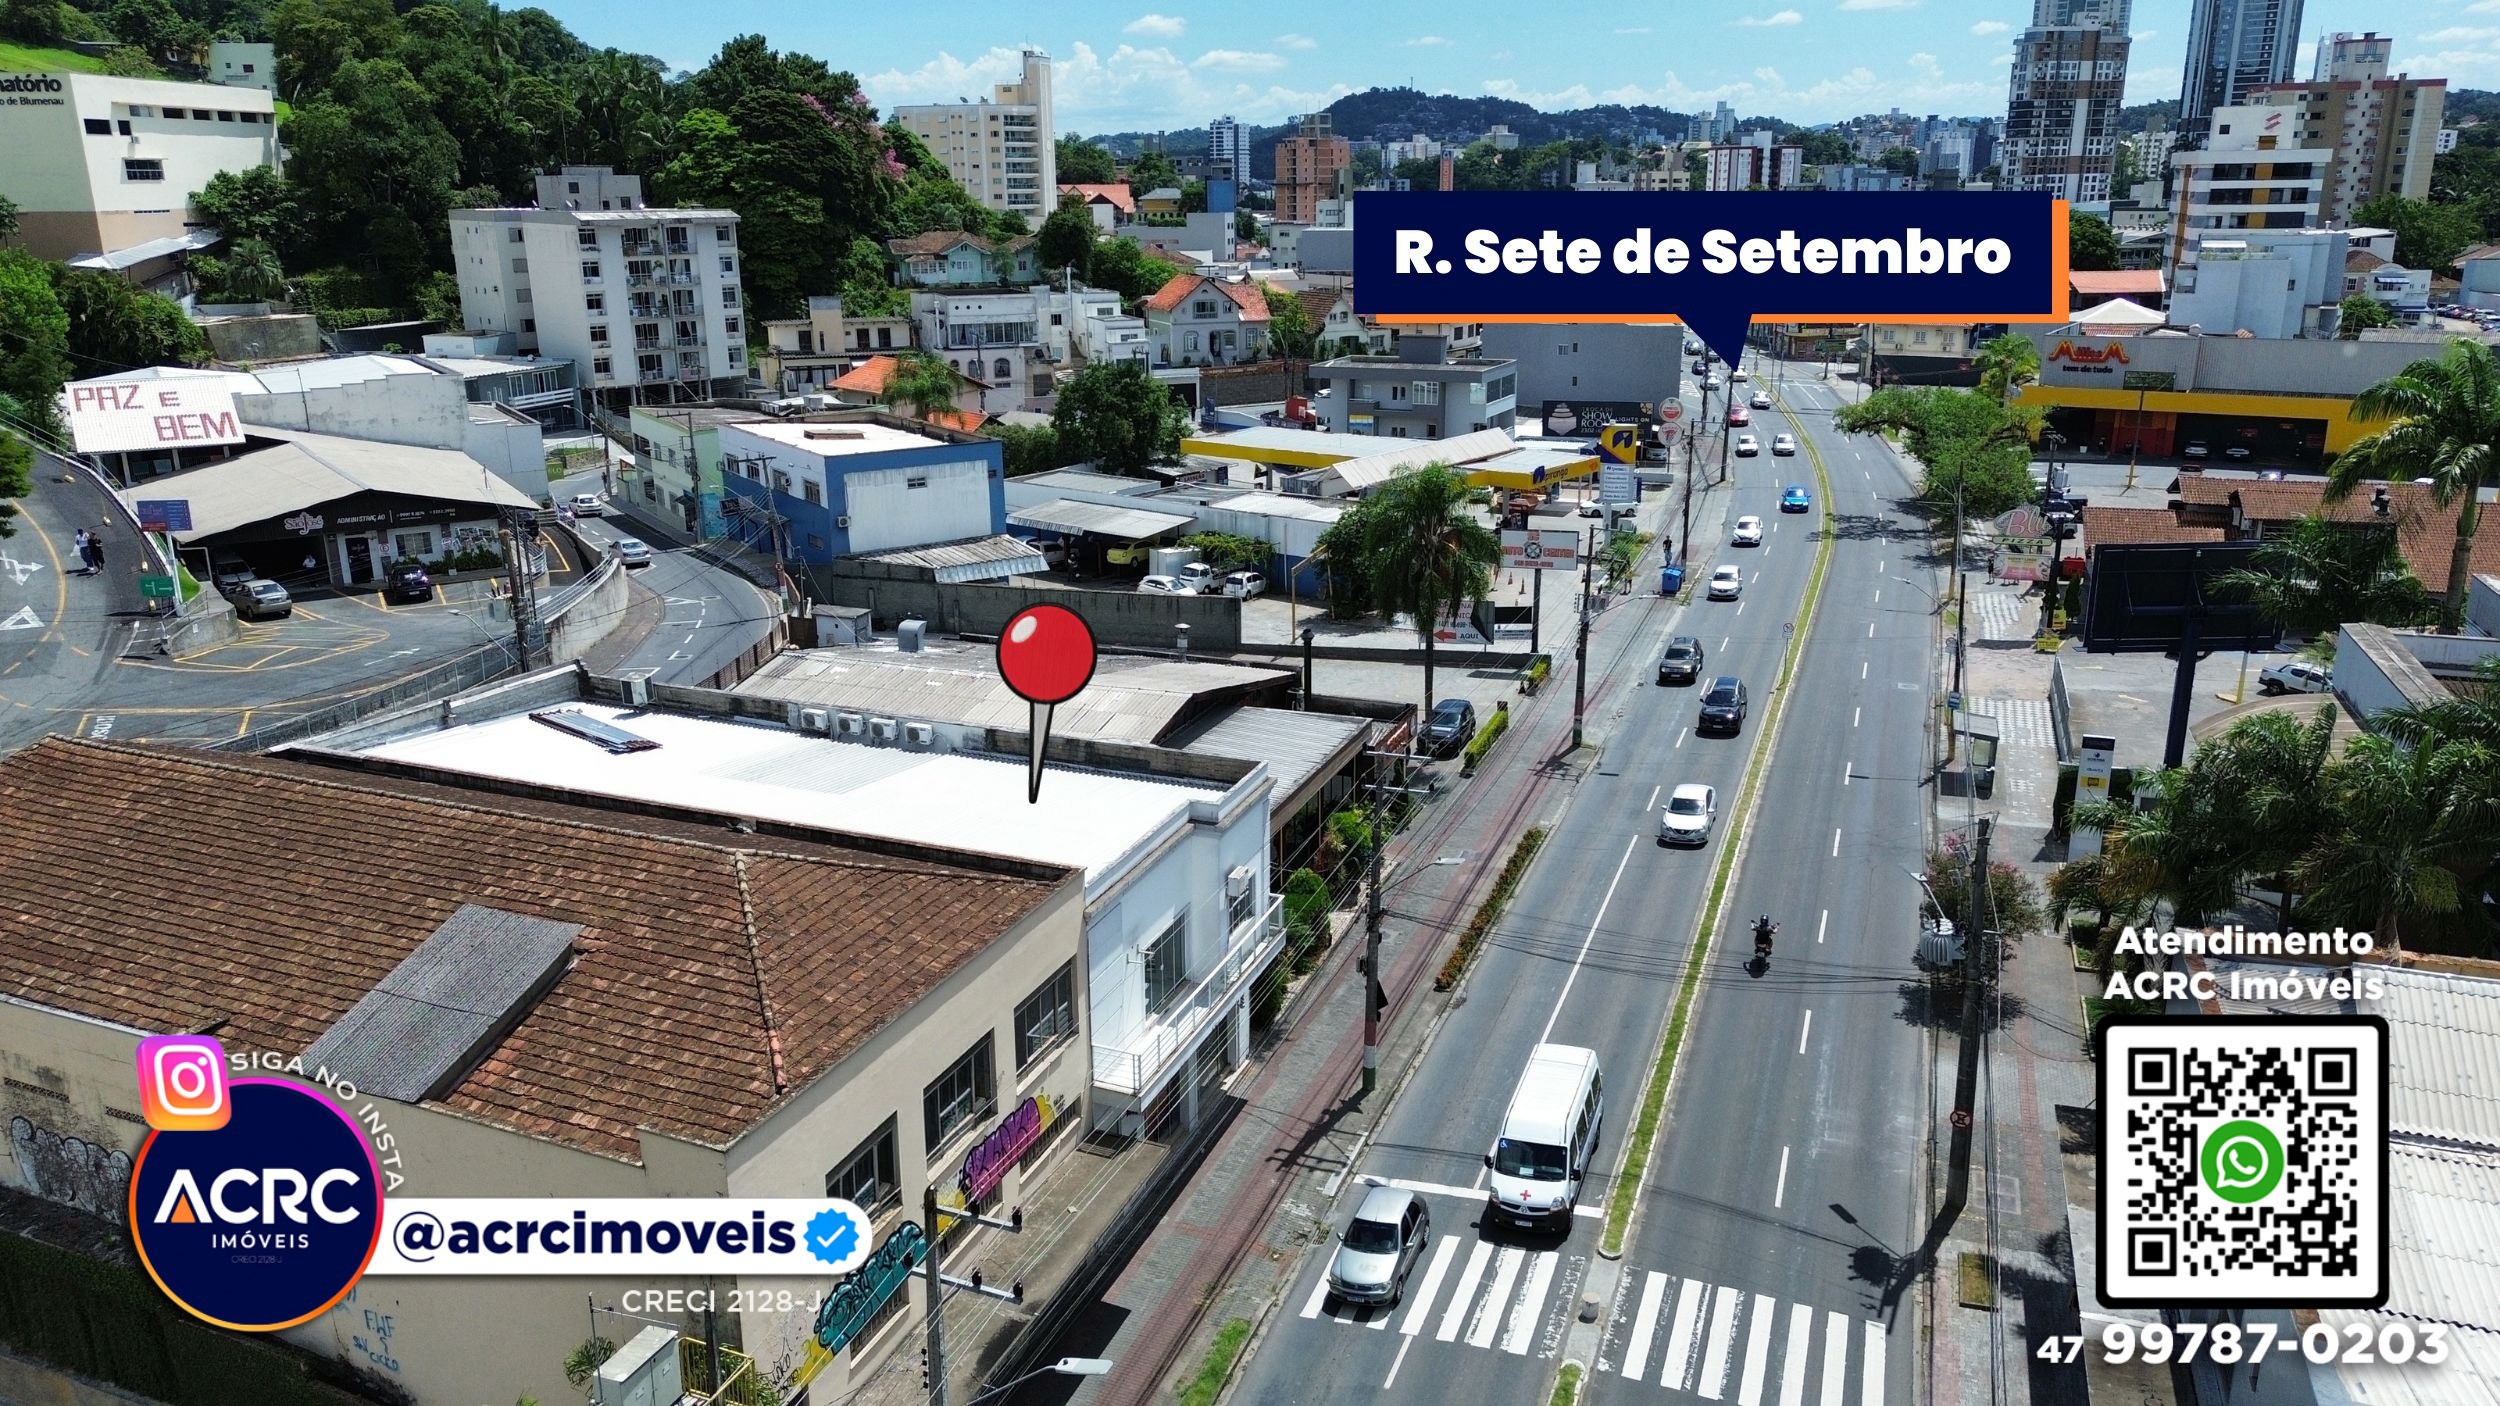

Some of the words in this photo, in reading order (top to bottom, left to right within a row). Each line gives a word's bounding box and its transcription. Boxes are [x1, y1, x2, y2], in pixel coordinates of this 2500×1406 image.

[7, 97, 18, 105] de
[19, 97, 64, 105] Blumenau
[73, 384, 144, 412] PAZ
[1581, 411, 1612, 421] SHOW
[153, 411, 238, 442] BEM
